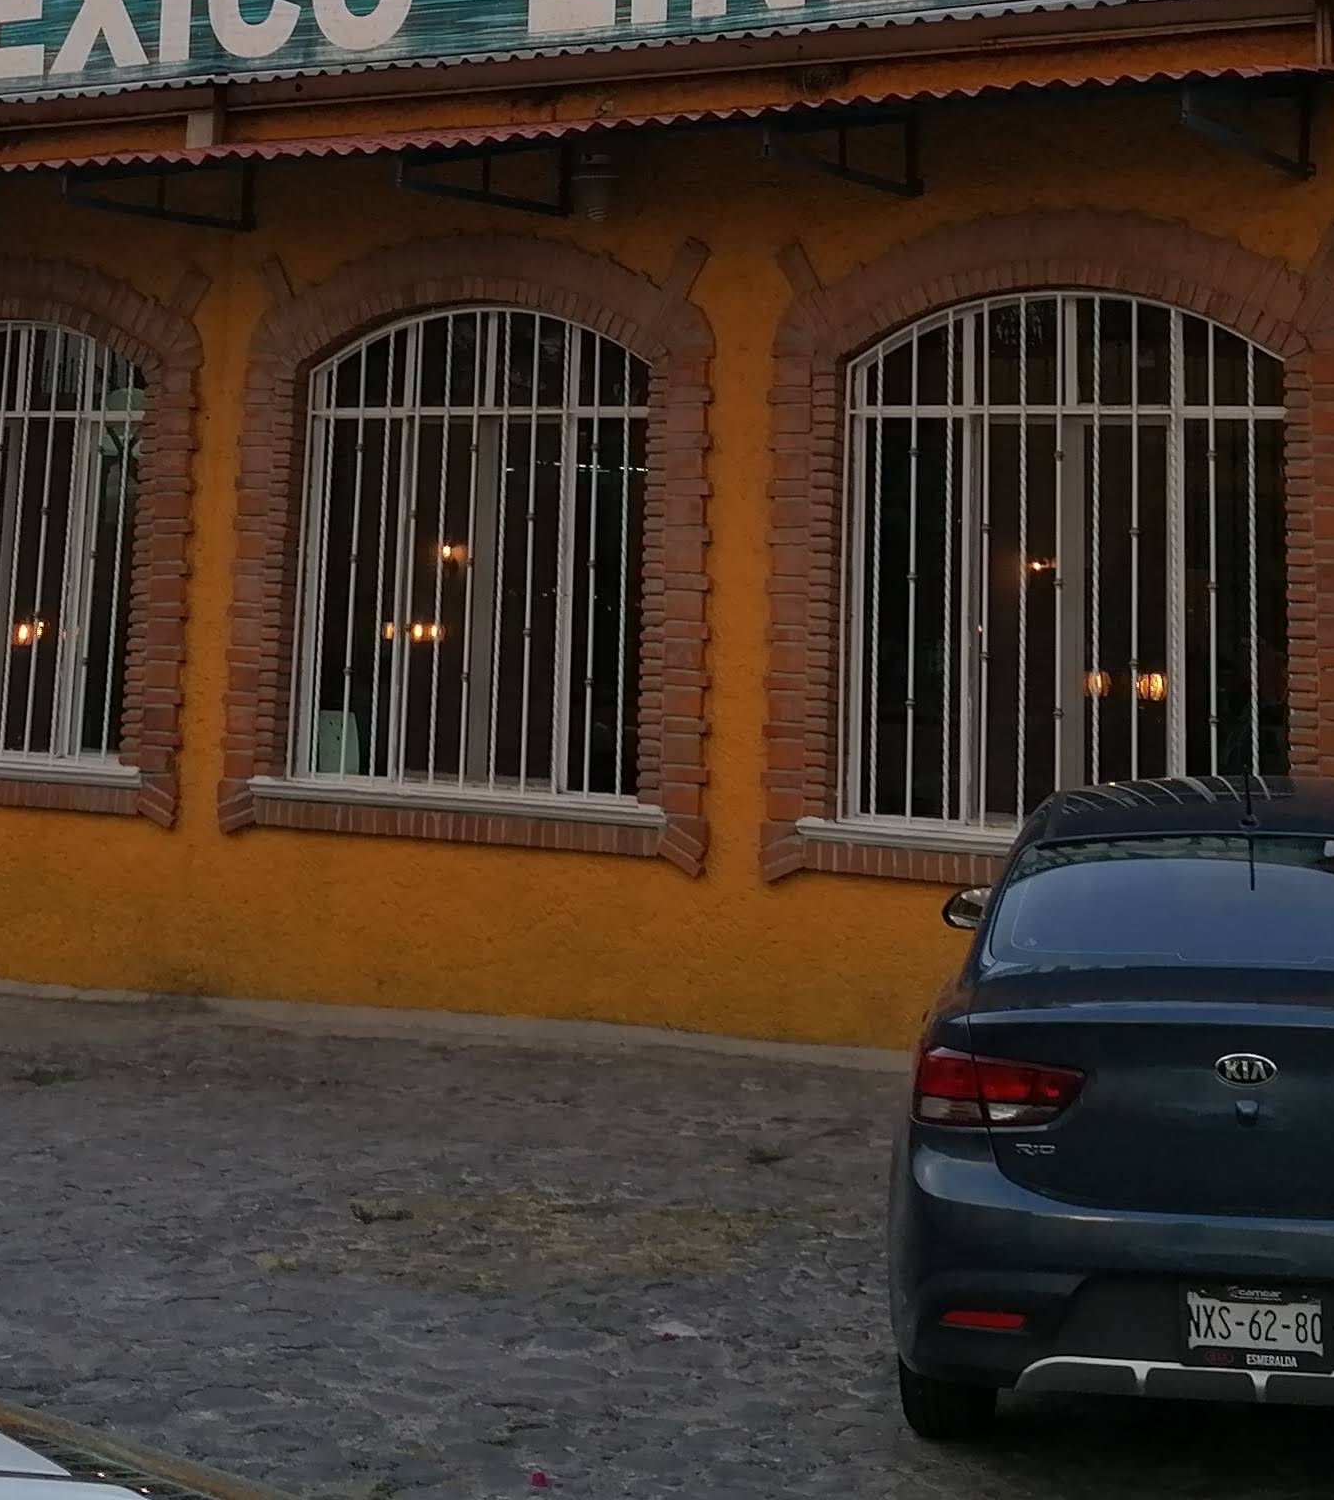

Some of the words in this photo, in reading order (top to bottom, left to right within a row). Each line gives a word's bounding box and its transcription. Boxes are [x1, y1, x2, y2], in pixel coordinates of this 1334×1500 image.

[1223, 1059, 1269, 1081] KIA
[1015, 1143, 1056, 1156] RIO
[1187, 1304, 1324, 1344] NXS-62-80
[1245, 1352, 1299, 1368] ESMERALDA
